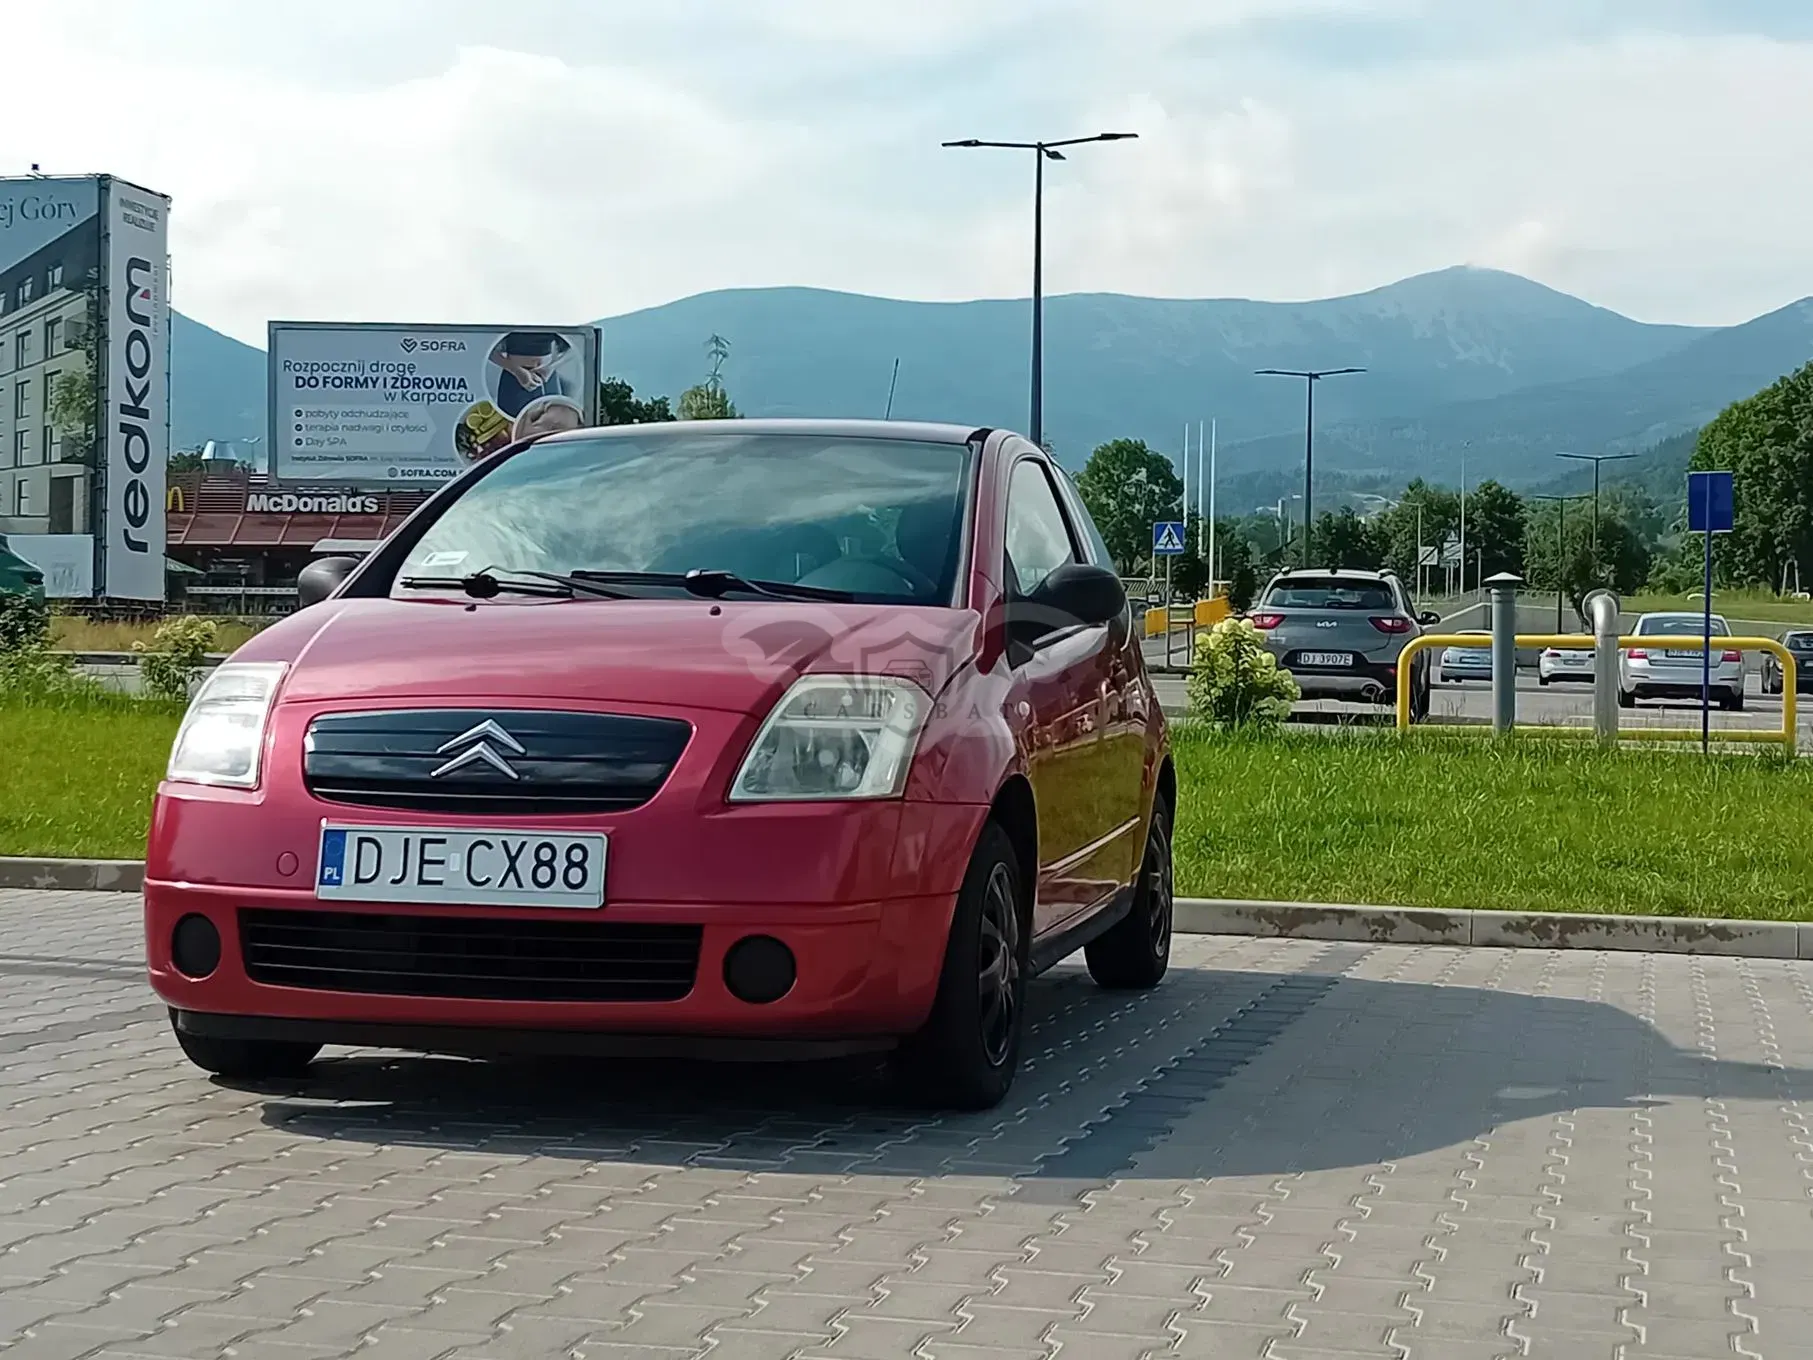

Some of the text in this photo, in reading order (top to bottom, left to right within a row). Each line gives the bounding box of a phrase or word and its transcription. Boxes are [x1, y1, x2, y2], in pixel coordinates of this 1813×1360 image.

[20, 194, 79, 228] Góry
[420, 340, 467, 351] SOFRA
[283, 359, 417, 376] Rozpocznij drogę
[294, 376, 468, 390] DO FORMY I ZDROWIA
[119, 256, 152, 554] redkom
[384, 390, 475, 405] w Karpaczu
[305, 409, 340, 419] pobyty
[305, 423, 340, 432] terapia
[305, 437, 348, 448] Day SPA
[400, 469, 466, 478] SOFRA.COM
[246, 494, 379, 513] McDonald's
[353, 836, 590, 891] DJE CX88
[323, 866, 341, 881] PL
